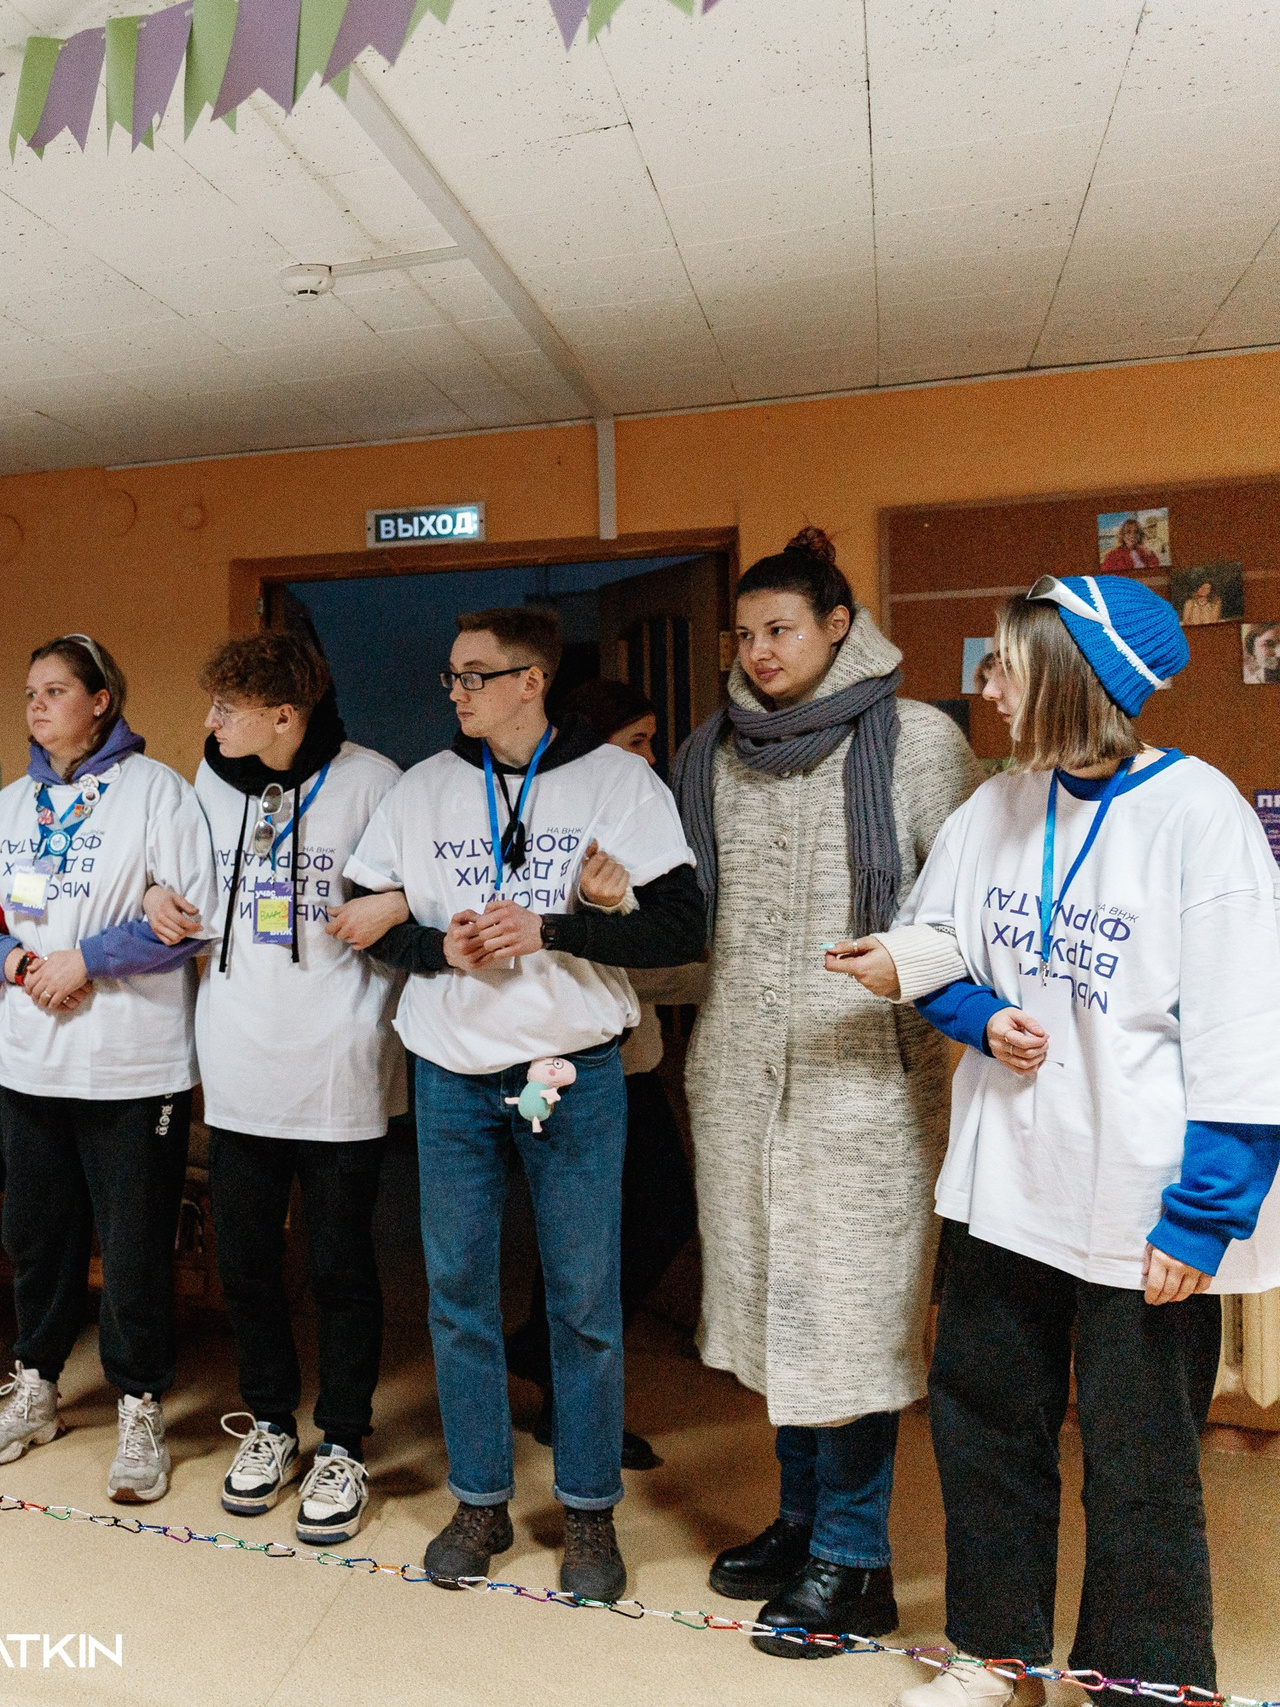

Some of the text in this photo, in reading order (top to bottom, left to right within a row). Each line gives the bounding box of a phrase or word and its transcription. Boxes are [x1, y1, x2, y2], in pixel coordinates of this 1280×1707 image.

[379, 511, 475, 540] ВЫХОД
[433, 833, 579, 860] ФОРАТАХ
[455, 857, 553, 887] ДРУИХ
